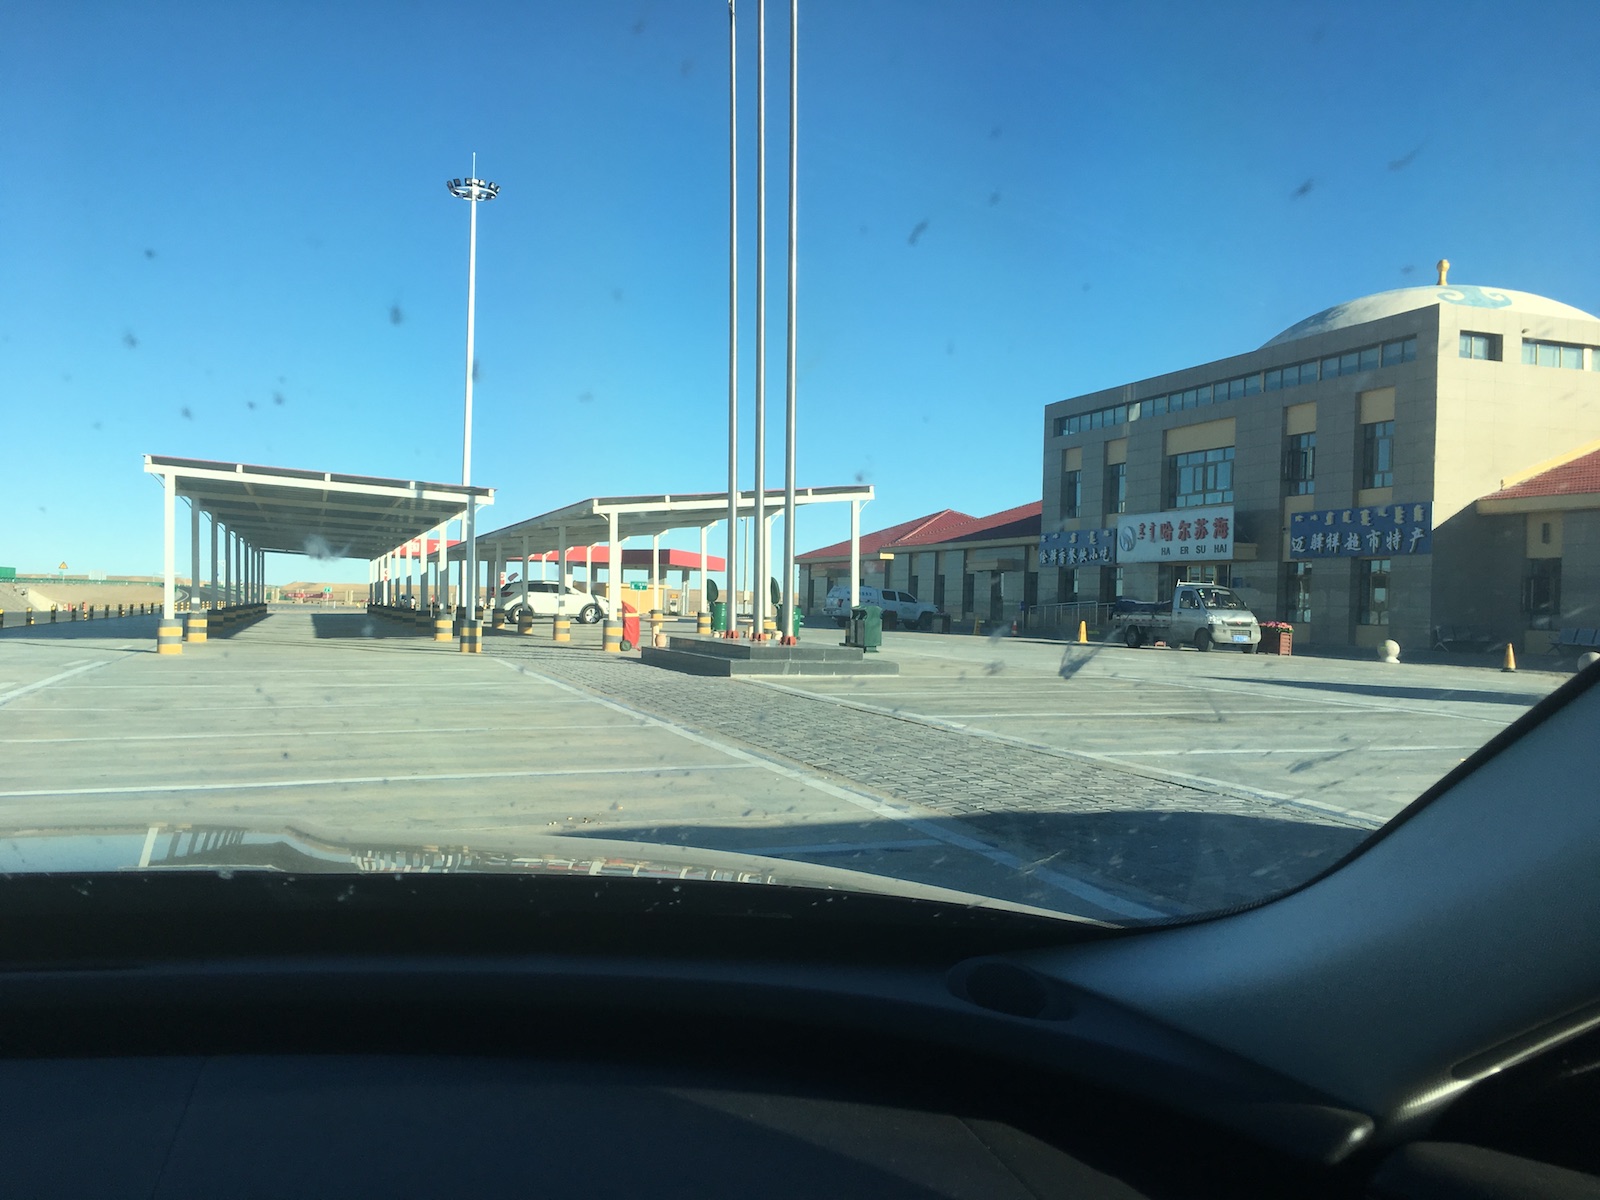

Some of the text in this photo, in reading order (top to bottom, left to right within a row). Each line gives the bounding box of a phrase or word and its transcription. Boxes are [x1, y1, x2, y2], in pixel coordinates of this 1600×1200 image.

[1160, 517, 1229, 542] 哈尔苏海
[1161, 544, 1227, 556] HA ER SU HAI
